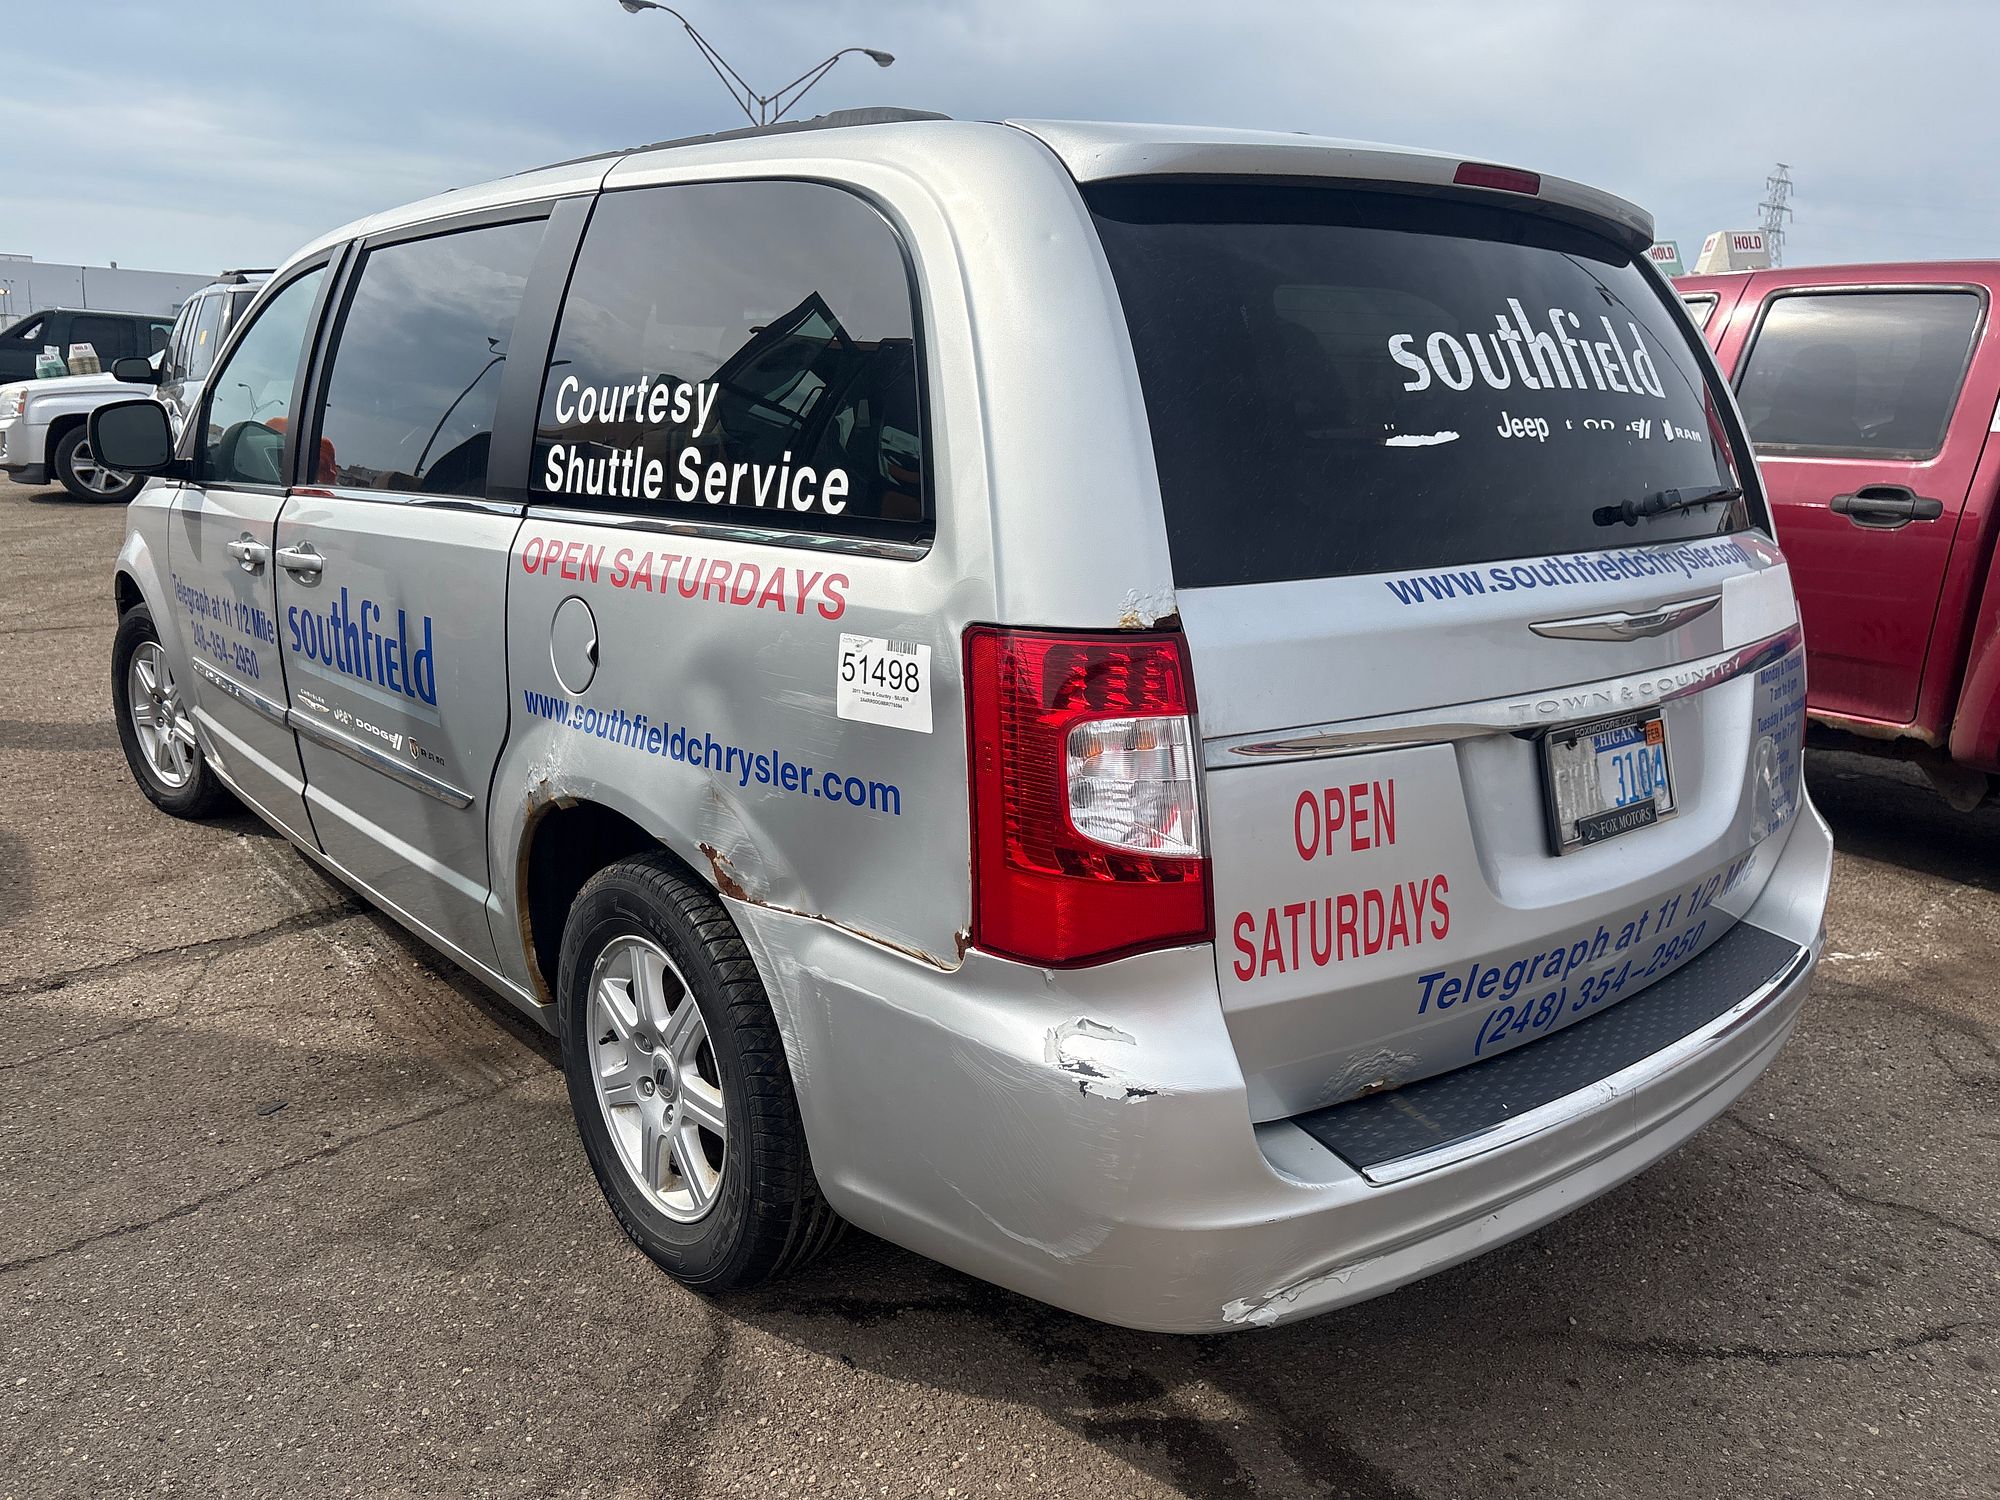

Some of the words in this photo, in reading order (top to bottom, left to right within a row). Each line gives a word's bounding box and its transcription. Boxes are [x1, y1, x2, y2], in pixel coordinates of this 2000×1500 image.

[1651, 247, 1675, 260] HOLD
[1734, 236, 1762, 250] HOLD
[1387, 298, 1666, 398] southfield
[555, 375, 719, 437] Courtesy
[1497, 411, 1549, 443] Jeep
[1674, 427, 1702, 442] RAM
[545, 444, 663, 499] Shuttle
[675, 447, 849, 514] Service
[522, 536, 605, 584] OPEN
[610, 548, 850, 621] SATURDAYS
[1386, 541, 1752, 606] www.southfieldchrysler.com
[172, 572, 211, 620] Telegraph
[212, 595, 221, 622] at
[223, 597, 232, 627] 11
[235, 602, 251, 635] 1/2
[251, 607, 275, 645] Mile
[288, 587, 437, 706] southfield
[842, 652, 920, 693] 51498
[1509, 690, 1611, 720] TOWN
[1620, 687, 1633, 700] &
[1639, 657, 1741, 695] COUNTRY
[355, 718, 397, 743] DODGE
[524, 689, 902, 816] www.southfieldchrysler.com
[1575, 715, 1638, 737] FOXMOTORS.COM
[1594, 727, 1636, 749] CHIGAN
[1647, 728, 1660, 740] FEB
[1294, 778, 1396, 862] OPEN
[1600, 817, 1618, 836] FOX
[1619, 807, 1651, 827] MOTORS
[1233, 874, 1450, 982] SATURDAYS
[1417, 926, 1610, 1015] Telegraph
[1615, 910, 1649, 951] at
[1655, 894, 1682, 934] 11
[1687, 873, 1721, 918] 1/2
[1719, 856, 1757, 898] Mile
[1474, 987, 1567, 1056] (248)
[1572, 920, 1707, 1012] 354-2950
